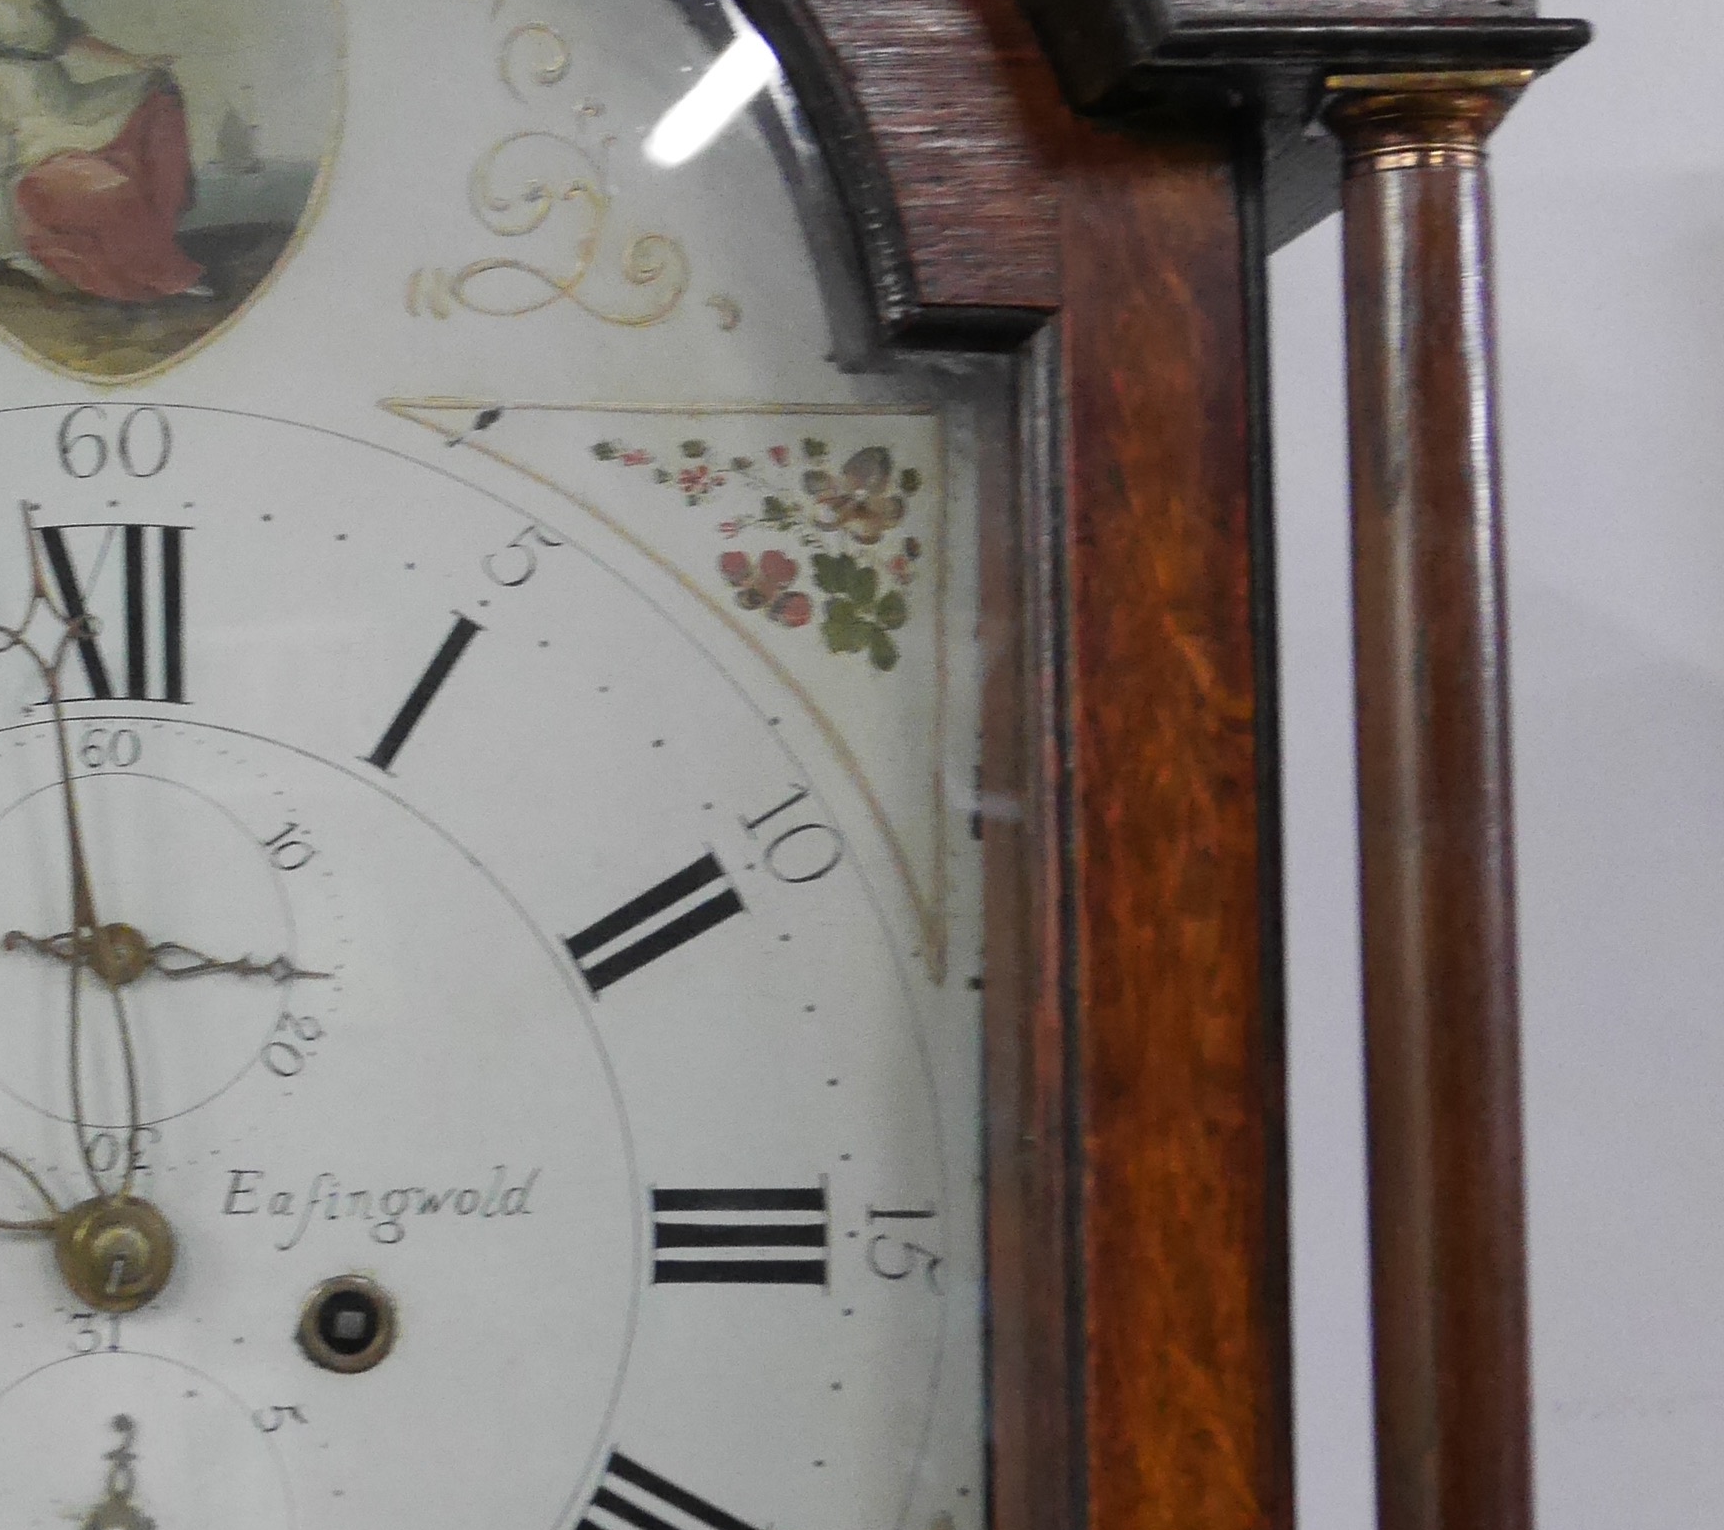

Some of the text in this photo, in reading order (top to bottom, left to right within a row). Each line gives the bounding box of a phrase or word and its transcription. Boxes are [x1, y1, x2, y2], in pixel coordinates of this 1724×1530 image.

[57, 405, 171, 478] 60
[482, 526, 562, 586] 5
[32, 523, 194, 704] XII
[357, 610, 488, 777] I
[79, 728, 142, 767] 60
[262, 822, 319, 870] 10
[738, 782, 843, 882] 10
[557, 842, 751, 1002] II
[260, 1012, 325, 1076] 20
[85, 1127, 161, 1172] 30
[650, 1173, 829, 1295] III
[865, 1200, 944, 1295] 15
